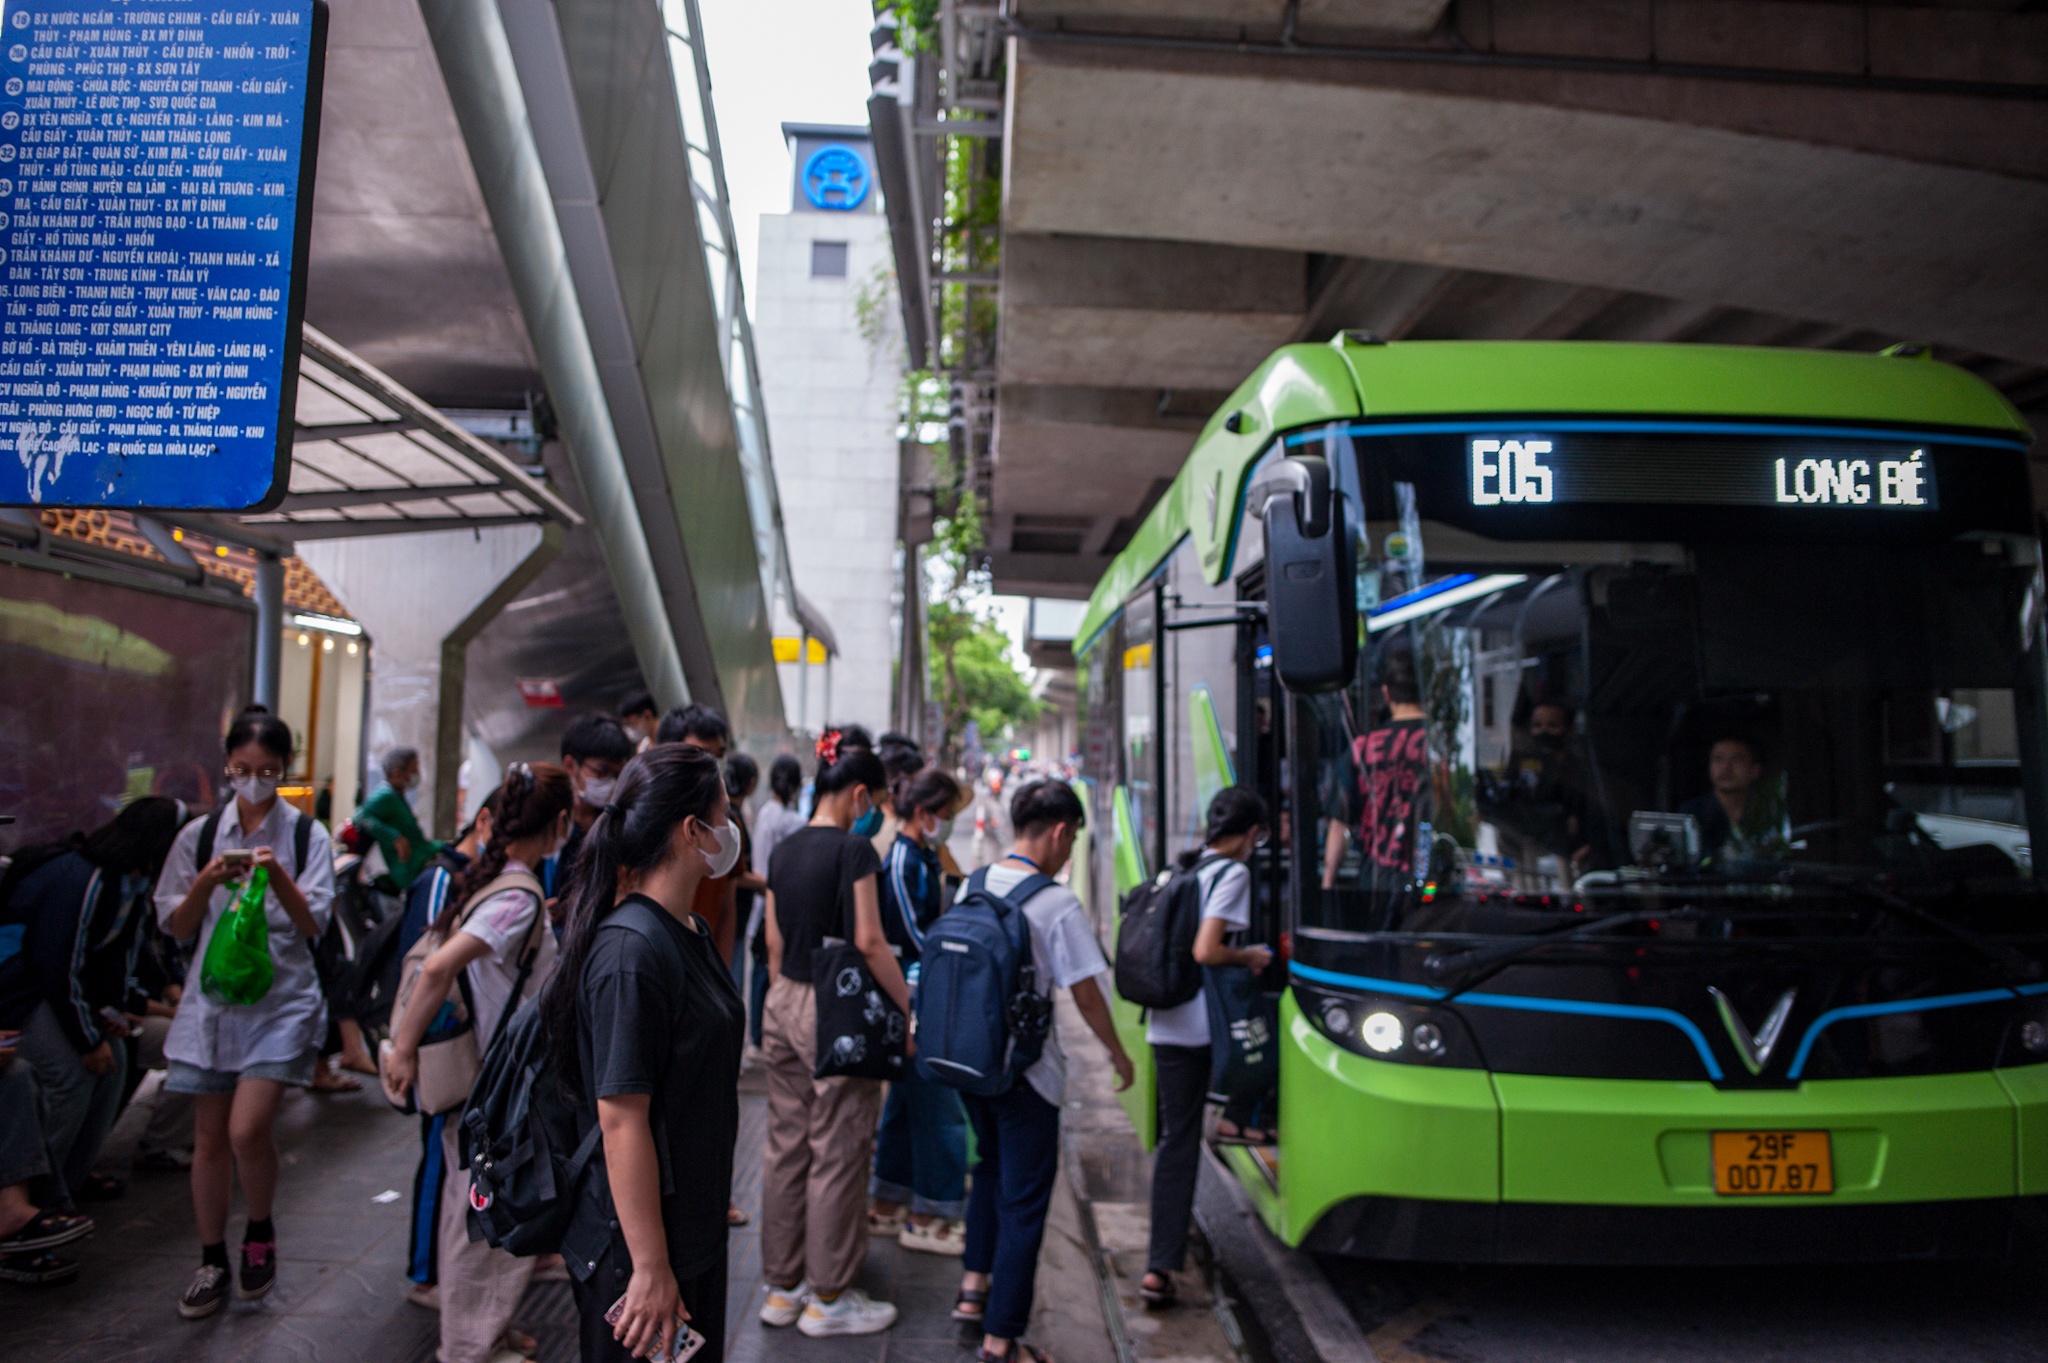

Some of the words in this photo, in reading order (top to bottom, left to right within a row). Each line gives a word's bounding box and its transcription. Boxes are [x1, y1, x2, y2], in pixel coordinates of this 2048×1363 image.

[34, 13, 48, 24] BX
[168, 13, 201, 25] CHINH
[141, 30, 156, 41] BX
[137, 63, 152, 74] BX
[27, 80, 46, 92] MAI
[201, 82, 233, 93] THANH
[149, 97, 168, 109] SVĐ
[199, 97, 217, 109] GIA
[4, 115, 16, 125] 27
[23, 114, 36, 125] BX
[101, 114, 114, 127] QL
[116, 114, 123, 126] 6
[243, 115, 263, 126] KIM
[141, 131, 165, 143] NAM
[204, 132, 231, 143] LONG
[19, 147, 33, 159] BX
[147, 148, 168, 160] KIM
[18, 181, 28, 193] TT
[127, 182, 142, 194] GIA
[181, 183, 199, 195] HAI
[263, 184, 285, 196] KIM
[165, 199, 178, 212] BX
[196, 217, 209, 230] LA
[189, 253, 223, 265] THANH
[94, 269, 128, 281] TRUNG
[14, 285, 40, 298] LONG
[75, 286, 108, 299] THANH
[230, 288, 250, 301] CAO
[69, 304, 88, 317] ĐTC
[4, 322, 17, 334] ĐL
[55, 323, 81, 335] LONG
[91, 323, 110, 336] KĐT
[112, 323, 147, 336] SMART
[149, 324, 171, 336] CITY
[189, 365, 203, 378] BX
[173, 386, 193, 398] DUY
[95, 405, 117, 419] (HĐ)
[169, 425, 180, 437] ĐL
[214, 426, 238, 438] LONG
[245, 427, 265, 438] KHU
[148, 443, 163, 455] GIA
[1472, 440, 1552, 505] E05
[1775, 458, 1871, 504] LONG
[1747, 1134, 1795, 1161] 29F
[1728, 1164, 1818, 1190] 007.87
